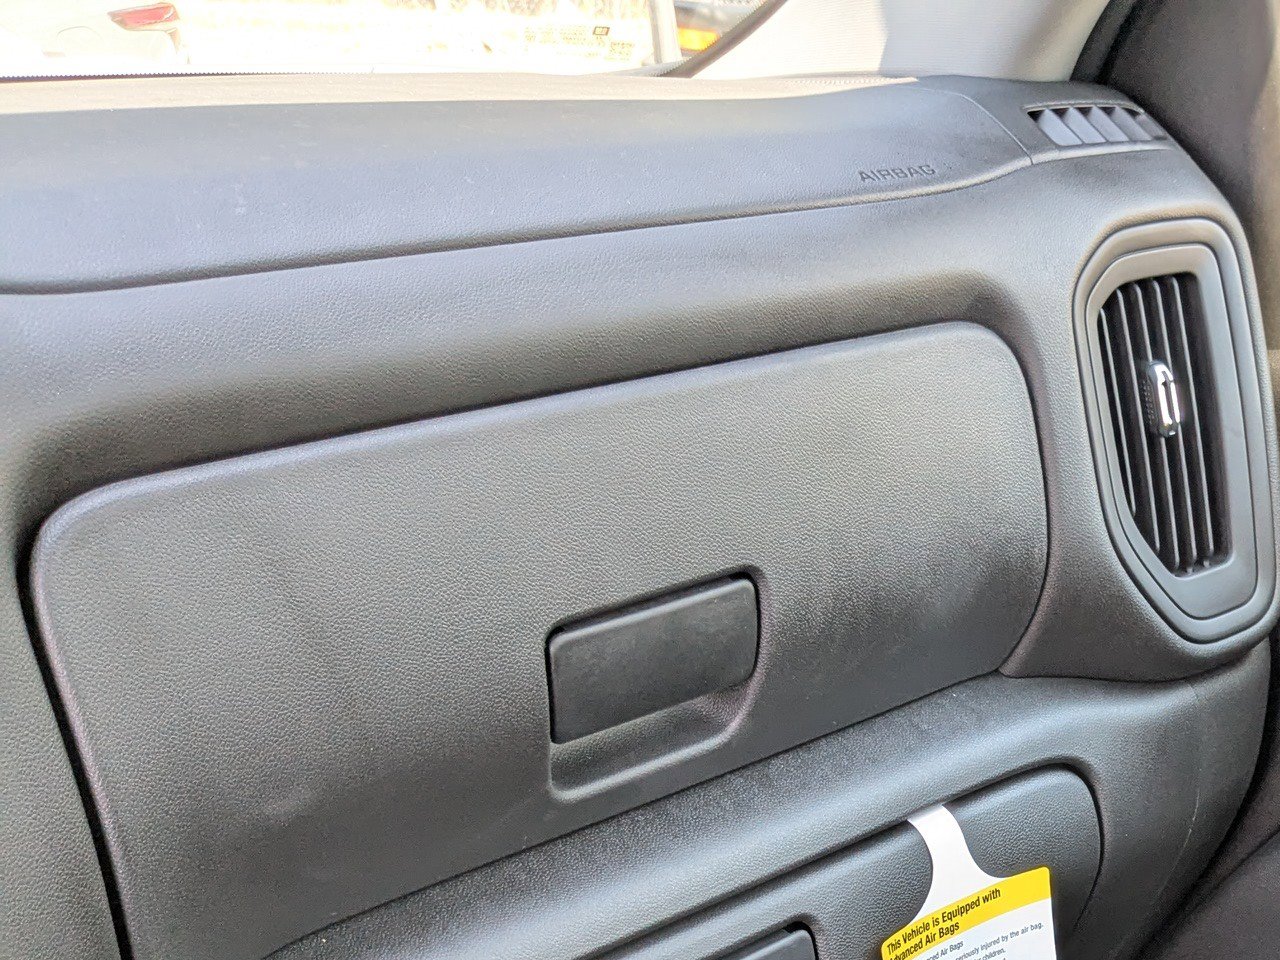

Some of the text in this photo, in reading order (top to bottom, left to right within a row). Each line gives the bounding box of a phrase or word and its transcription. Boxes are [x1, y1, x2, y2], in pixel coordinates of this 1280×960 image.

[858, 164, 937, 182] AIRBAG
[887, 888, 1001, 955] This Vehicle is Equipped with
[925, 932, 938, 946] Air
[938, 922, 960, 939] Bags
[980, 936, 1000, 952] injured
[1001, 932, 1009, 942] by
[1010, 930, 1020, 938] the
[1020, 925, 1029, 934] air
[1030, 922, 1044, 932] bag.
[940, 947, 948, 958] Air
[950, 940, 964, 952] Bags
